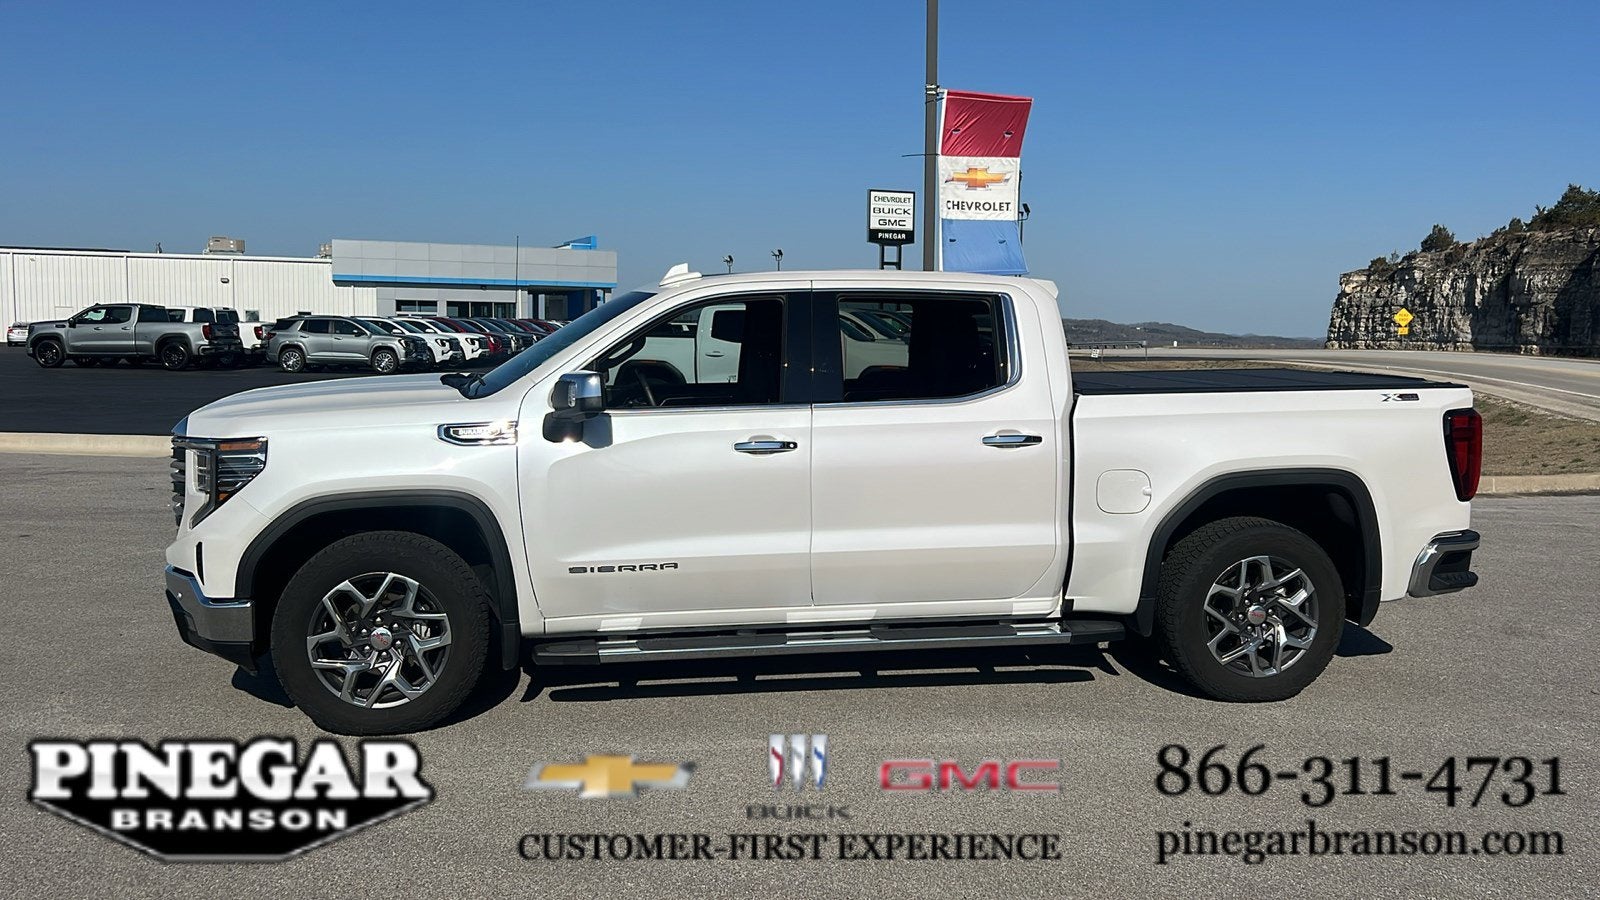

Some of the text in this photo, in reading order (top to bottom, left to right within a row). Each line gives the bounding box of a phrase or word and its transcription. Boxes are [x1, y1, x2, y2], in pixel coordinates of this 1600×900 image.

[873, 195, 911, 204] CHEVROLET
[946, 200, 1011, 212] CHEVROLET
[872, 207, 911, 215] BUICK
[878, 218, 906, 227] GMC
[878, 232, 906, 240] PINEGAR
[568, 562, 678, 574] SIERRA
